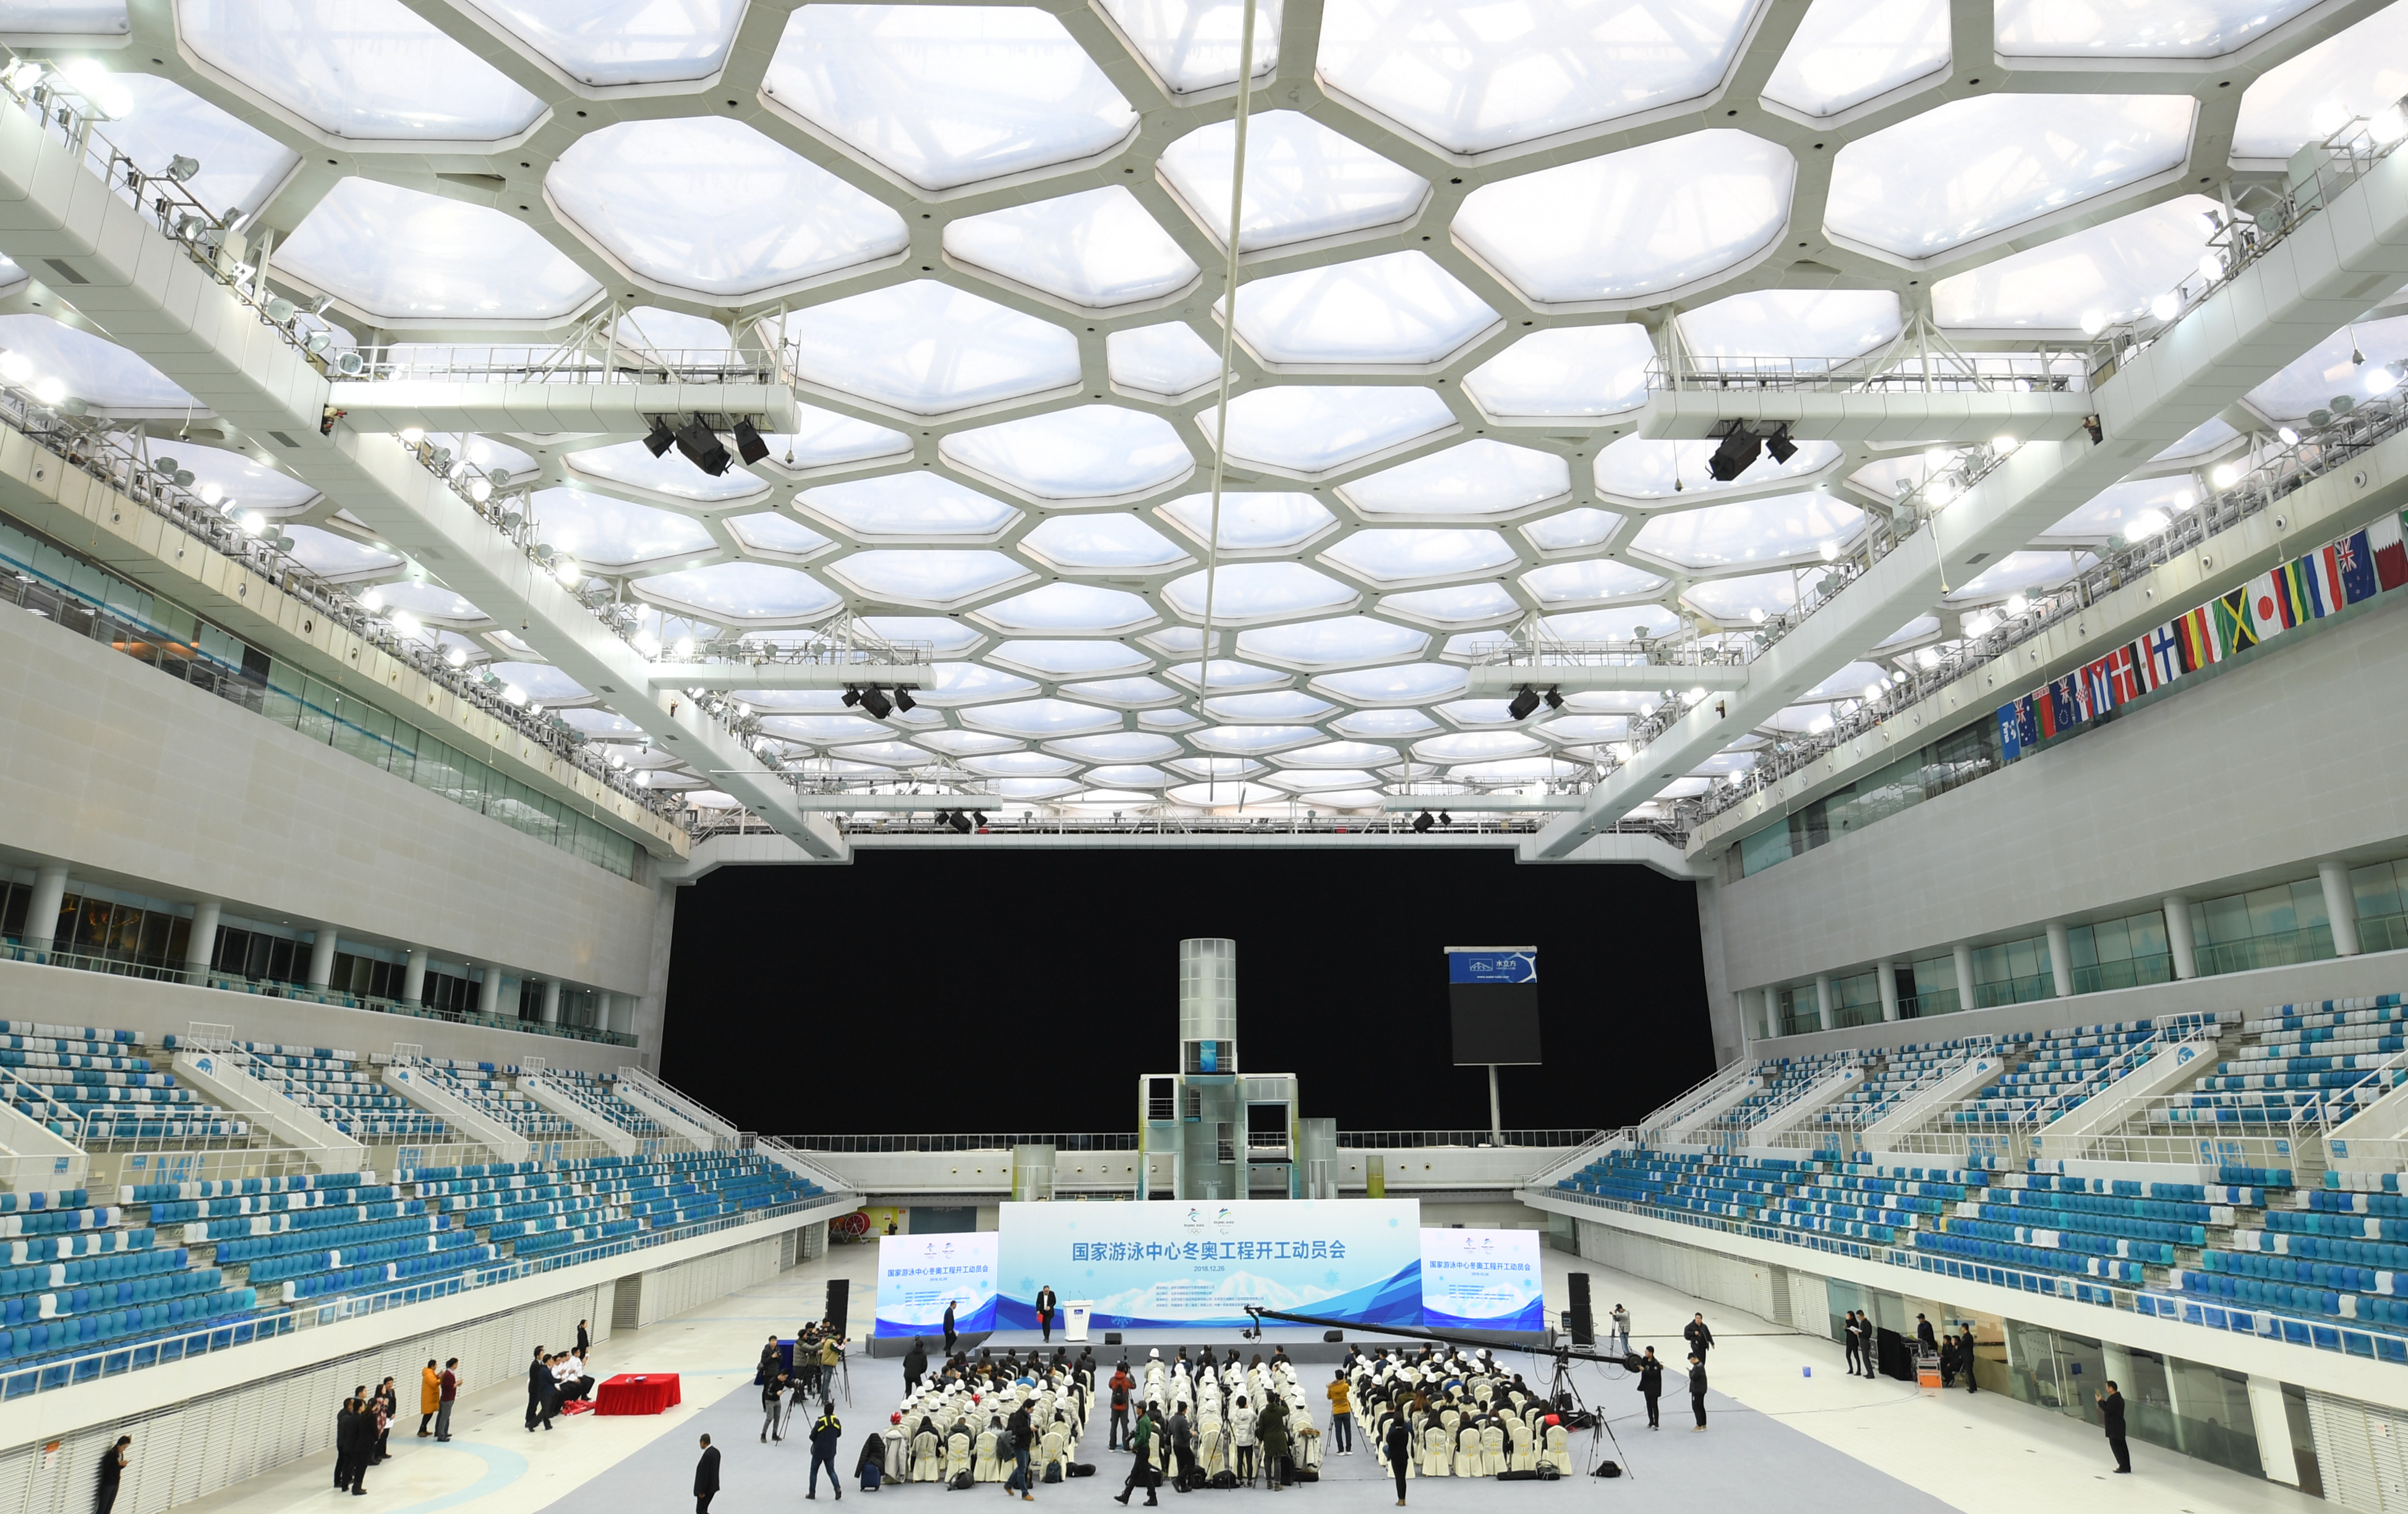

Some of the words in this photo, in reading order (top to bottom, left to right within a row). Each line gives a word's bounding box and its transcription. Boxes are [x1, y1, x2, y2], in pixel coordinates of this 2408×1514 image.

[154, 1157, 186, 1184] N4
[1072, 1240, 1346, 1261] 国家游泳中心冬奥工程开工动员会
[887, 1265, 989, 1277] 国家游泳中心冬奥工程开工动员会
[1430, 1261, 1531, 1271] 国家游泳中心冬奥工程开工动员会
